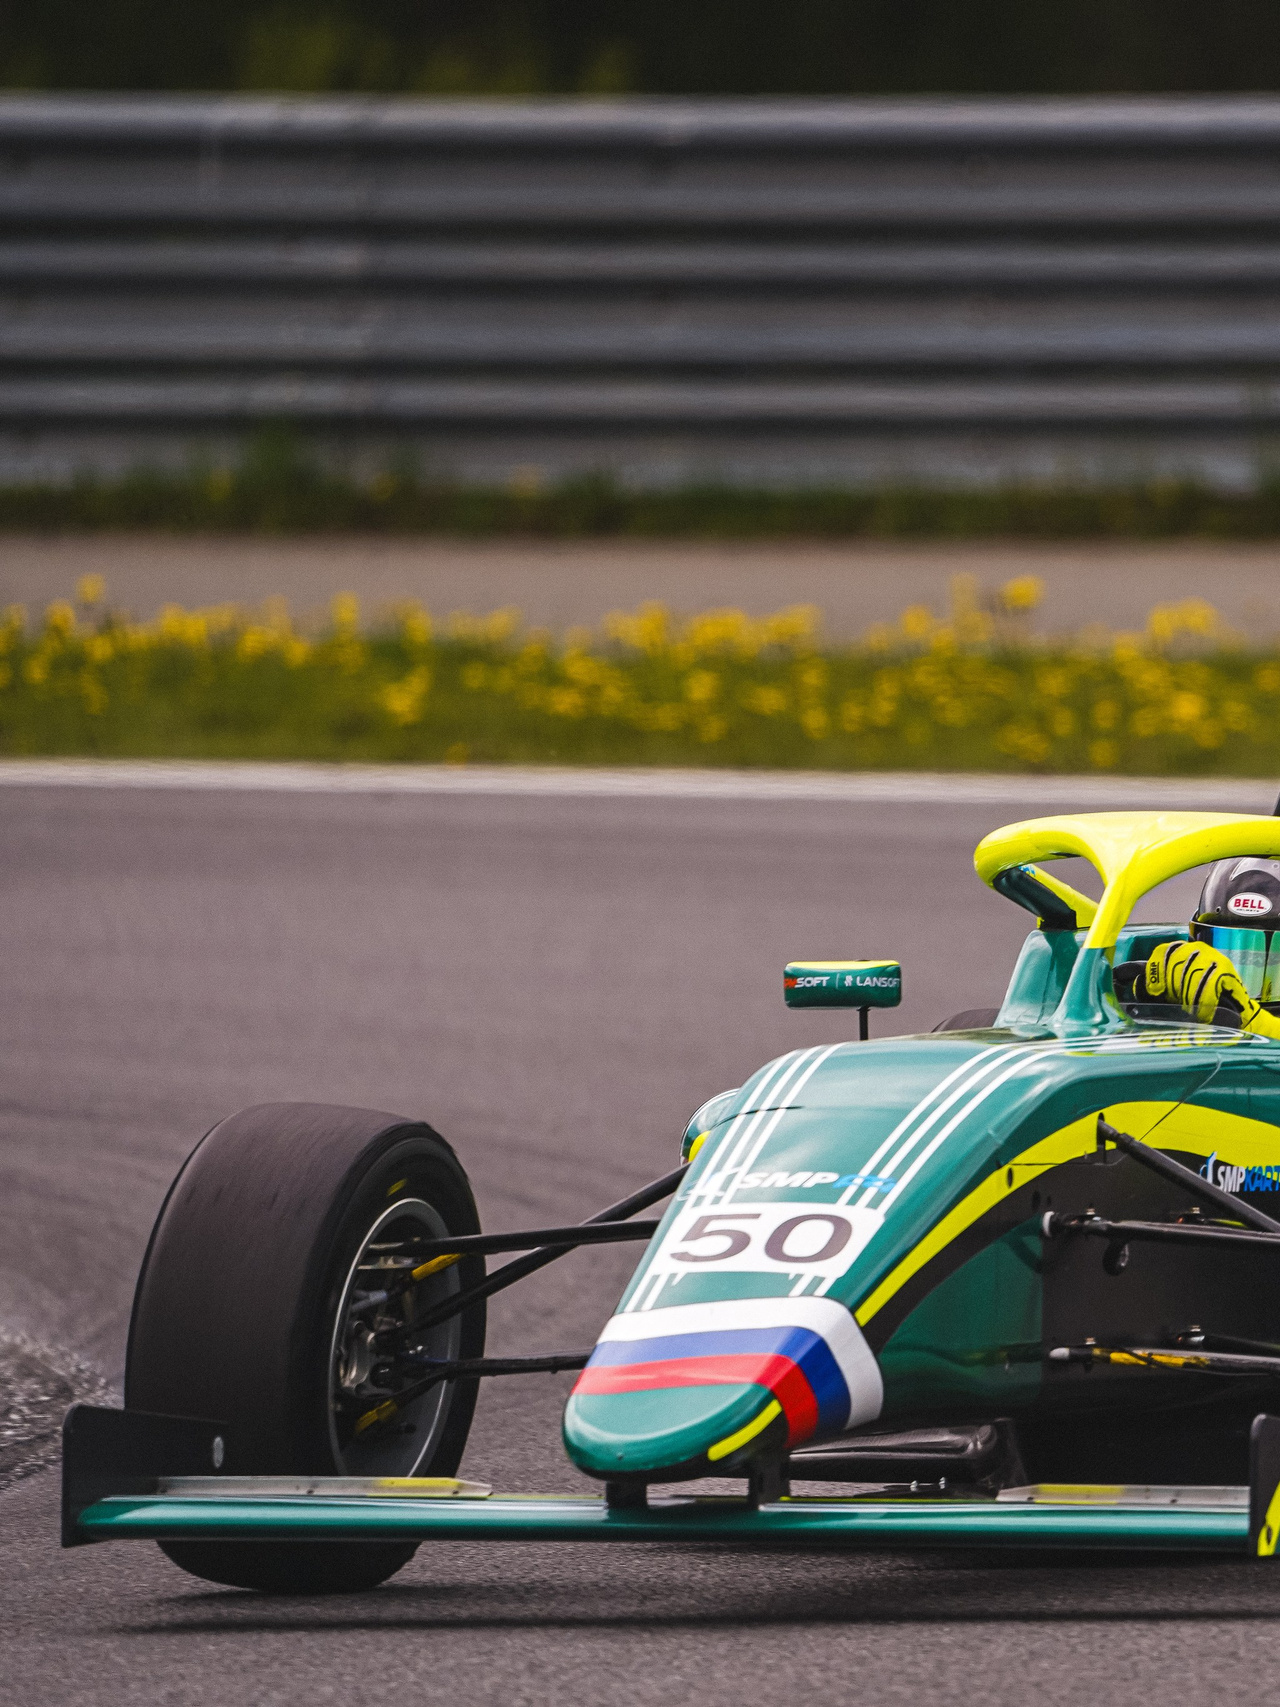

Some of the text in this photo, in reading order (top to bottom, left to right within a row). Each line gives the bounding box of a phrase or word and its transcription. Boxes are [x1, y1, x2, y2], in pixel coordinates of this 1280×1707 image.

[1233, 898, 1265, 910] BELL
[1150, 961, 1158, 984] OMP
[669, 1213, 853, 1264] 50
